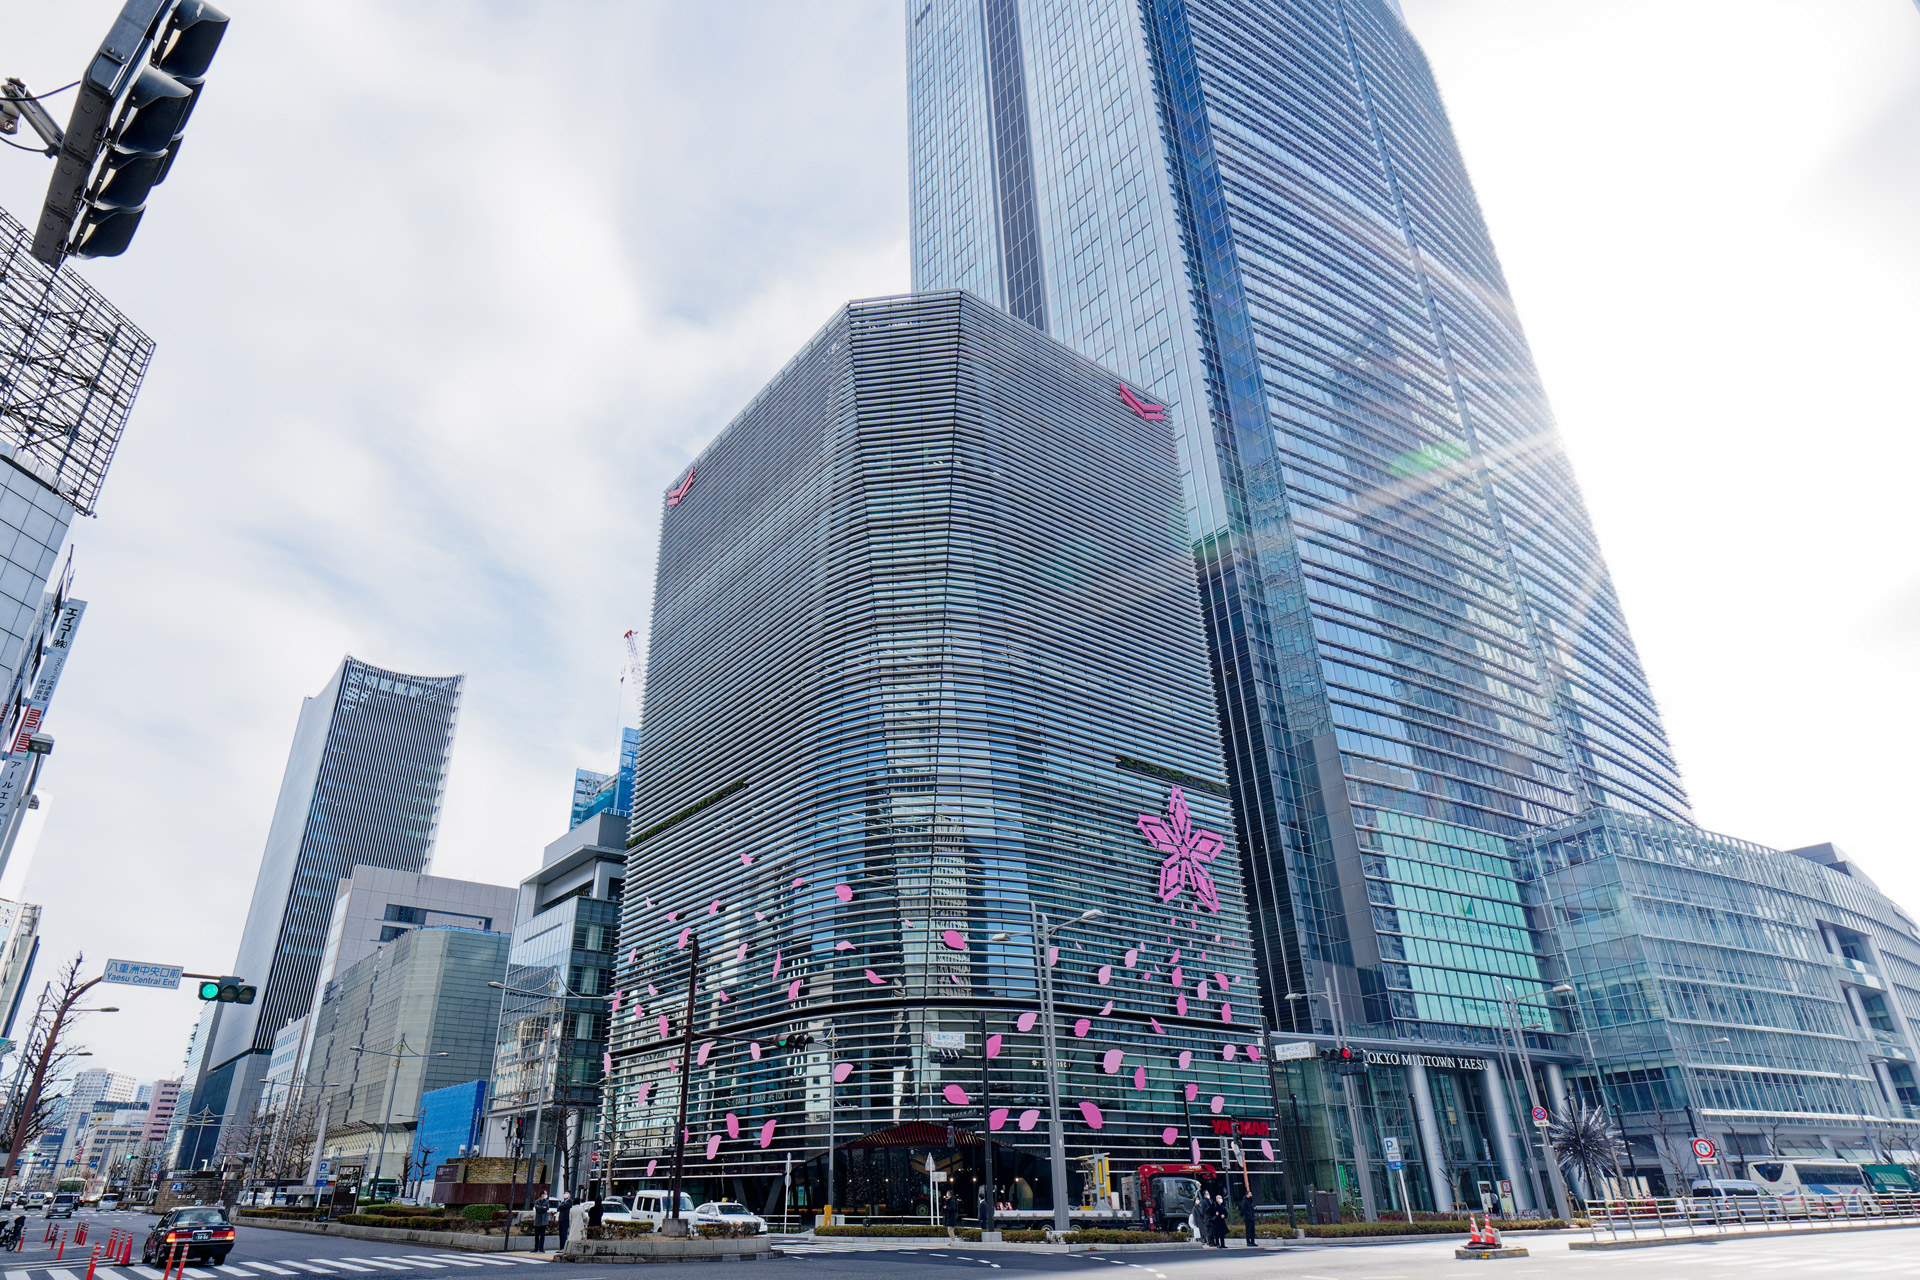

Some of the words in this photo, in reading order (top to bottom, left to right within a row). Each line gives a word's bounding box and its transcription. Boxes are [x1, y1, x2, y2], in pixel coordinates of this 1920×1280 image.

[107, 962, 180, 979] 八重洲中央口前
[107, 973, 130, 982] Yaesu
[132, 975, 160, 985] Central
[1401, 1054, 1456, 1068] MIDTOWN
[1457, 1058, 1489, 1070] YAESU
[1211, 1120, 1269, 1136] YAMAR
